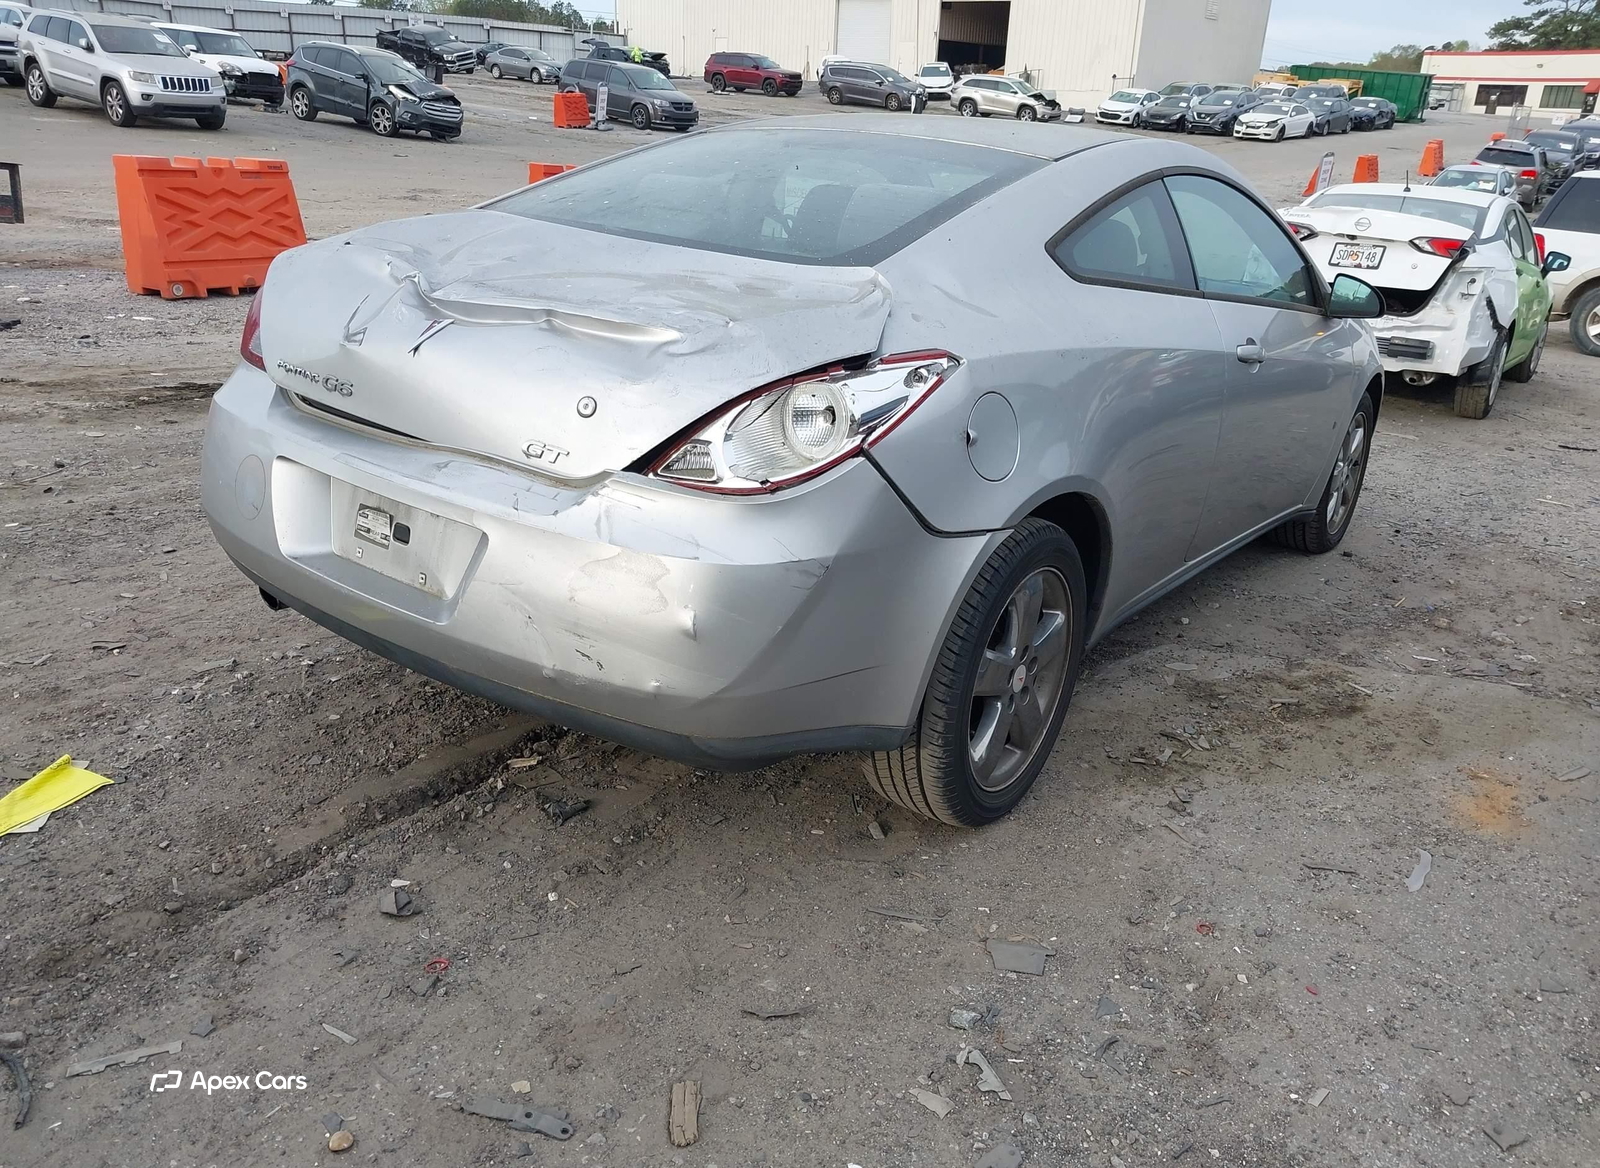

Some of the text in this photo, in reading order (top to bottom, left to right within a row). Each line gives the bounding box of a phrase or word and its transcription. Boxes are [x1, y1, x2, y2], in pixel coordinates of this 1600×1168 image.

[1336, 249, 1378, 263] SDP5148
[277, 360, 354, 397] PONTIAC G6
[521, 439, 570, 464] GT
